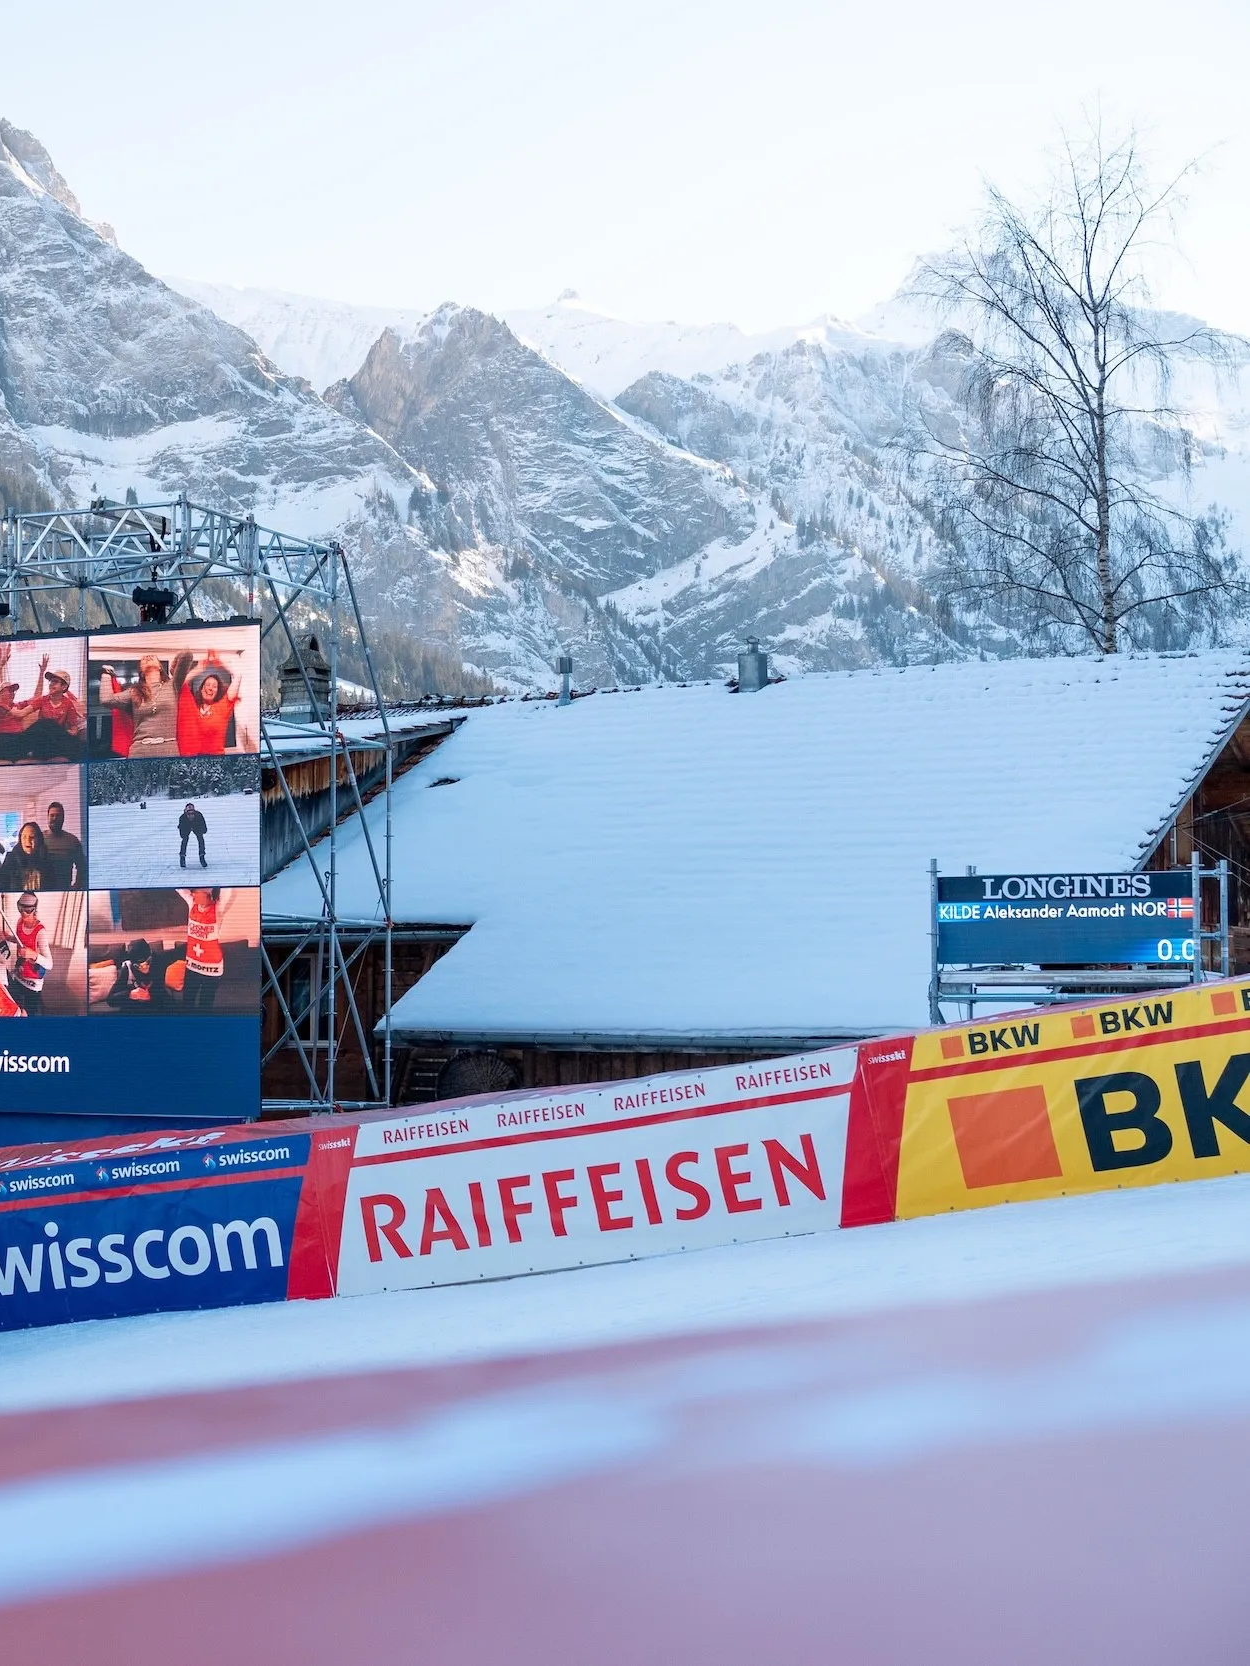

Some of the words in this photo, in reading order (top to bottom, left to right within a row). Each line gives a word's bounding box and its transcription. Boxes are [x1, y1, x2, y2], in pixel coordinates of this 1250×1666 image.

[982, 874, 1152, 900] LONGINES
[939, 905, 980, 919] KILDE
[983, 903, 1064, 919] Aleksander
[1066, 902, 1126, 918] Aamodt
[1131, 901, 1167, 917] NOR
[1099, 1001, 1173, 1035] BKW
[968, 1023, 1041, 1056] BKW
[867, 1049, 907, 1065] swissski
[735, 1062, 832, 1091] RAIFFEISEN
[613, 1082, 707, 1112] RAIFFEISEN
[496, 1102, 586, 1128] RAIFFEISEN
[318, 1137, 352, 1151] swissski
[383, 1118, 470, 1145] RAIFFEISEN
[111, 1158, 181, 1180] swisscom
[218, 1144, 290, 1168] swisscom
[9, 1171, 75, 1193] swisscom
[359, 1132, 828, 1263] RAIFFEISEN
